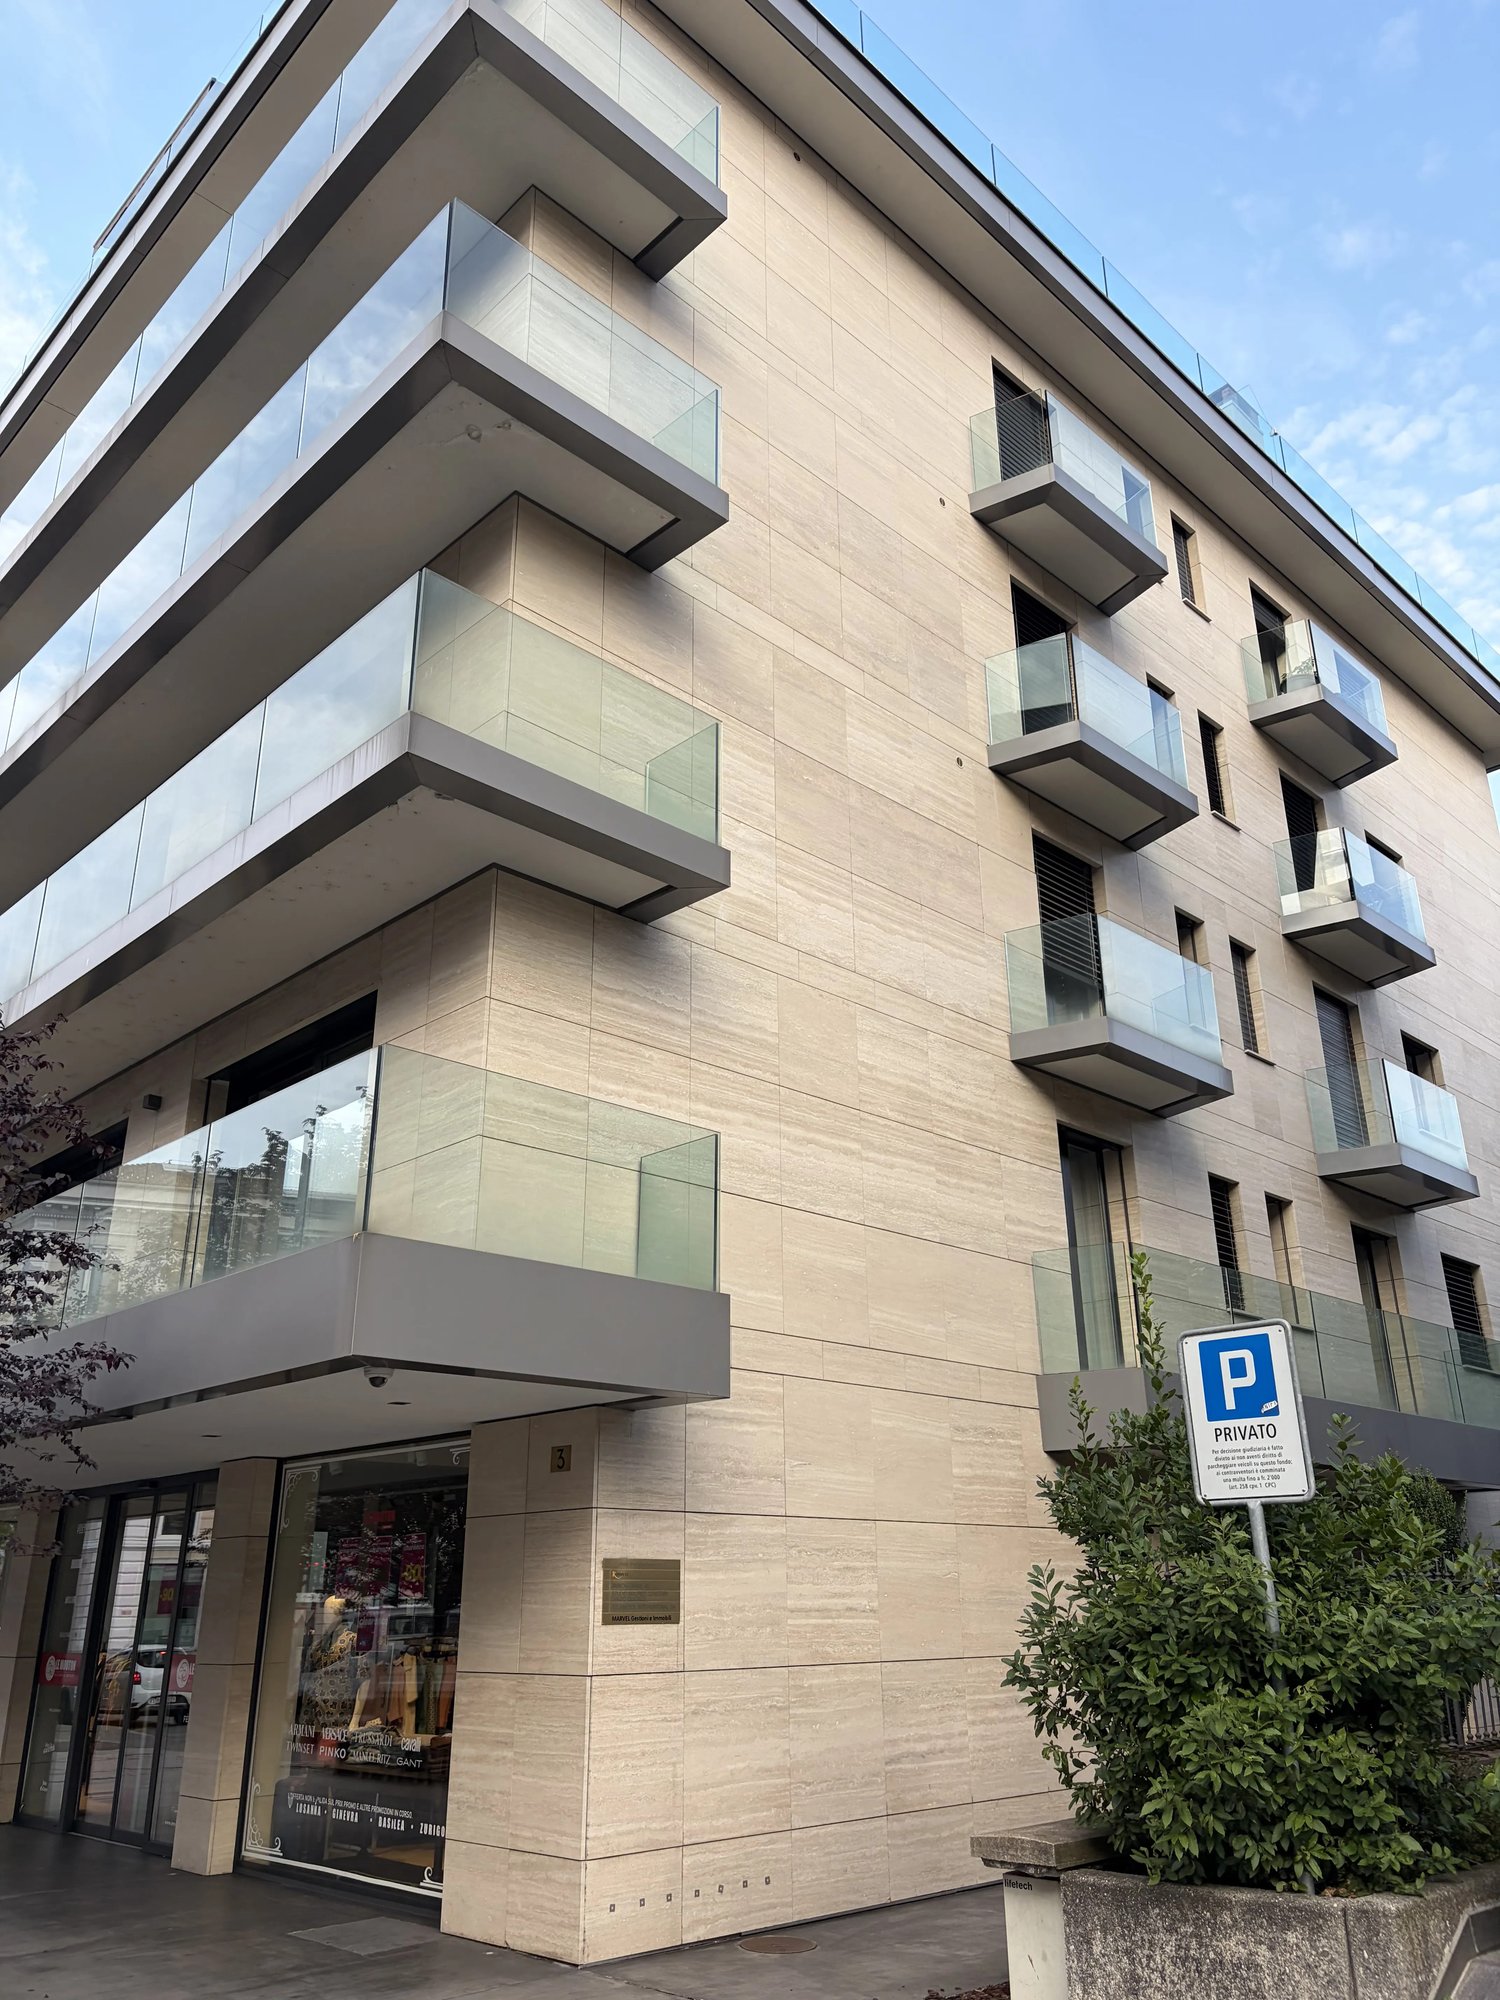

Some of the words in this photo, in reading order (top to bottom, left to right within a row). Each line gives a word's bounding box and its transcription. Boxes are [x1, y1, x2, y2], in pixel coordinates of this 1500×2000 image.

[1219, 1349, 1257, 1411] P
[1214, 1423, 1277, 1443] PRIVATO
[557, 1448, 565, 1469] 3
[1242, 1445, 1266, 1454] giudiziaria
[1221, 1468, 1255, 1476] contravventori
[289, 1723, 316, 1738] ARMANI
[321, 1727, 348, 1742] VERSACE
[353, 1731, 393, 1747] TRUSSARDI
[286, 1741, 315, 1754] TWINSET
[319, 1745, 347, 1759] PINKO
[396, 1757, 423, 1768] GANT
[295, 1802, 321, 1816] LOSANNA
[332, 1807, 359, 1823] GINEVRA
[378, 1816, 405, 1831] BASILEA
[419, 1822, 446, 1838] ZURIGO
[1004, 1878, 1033, 1891] lifetech
